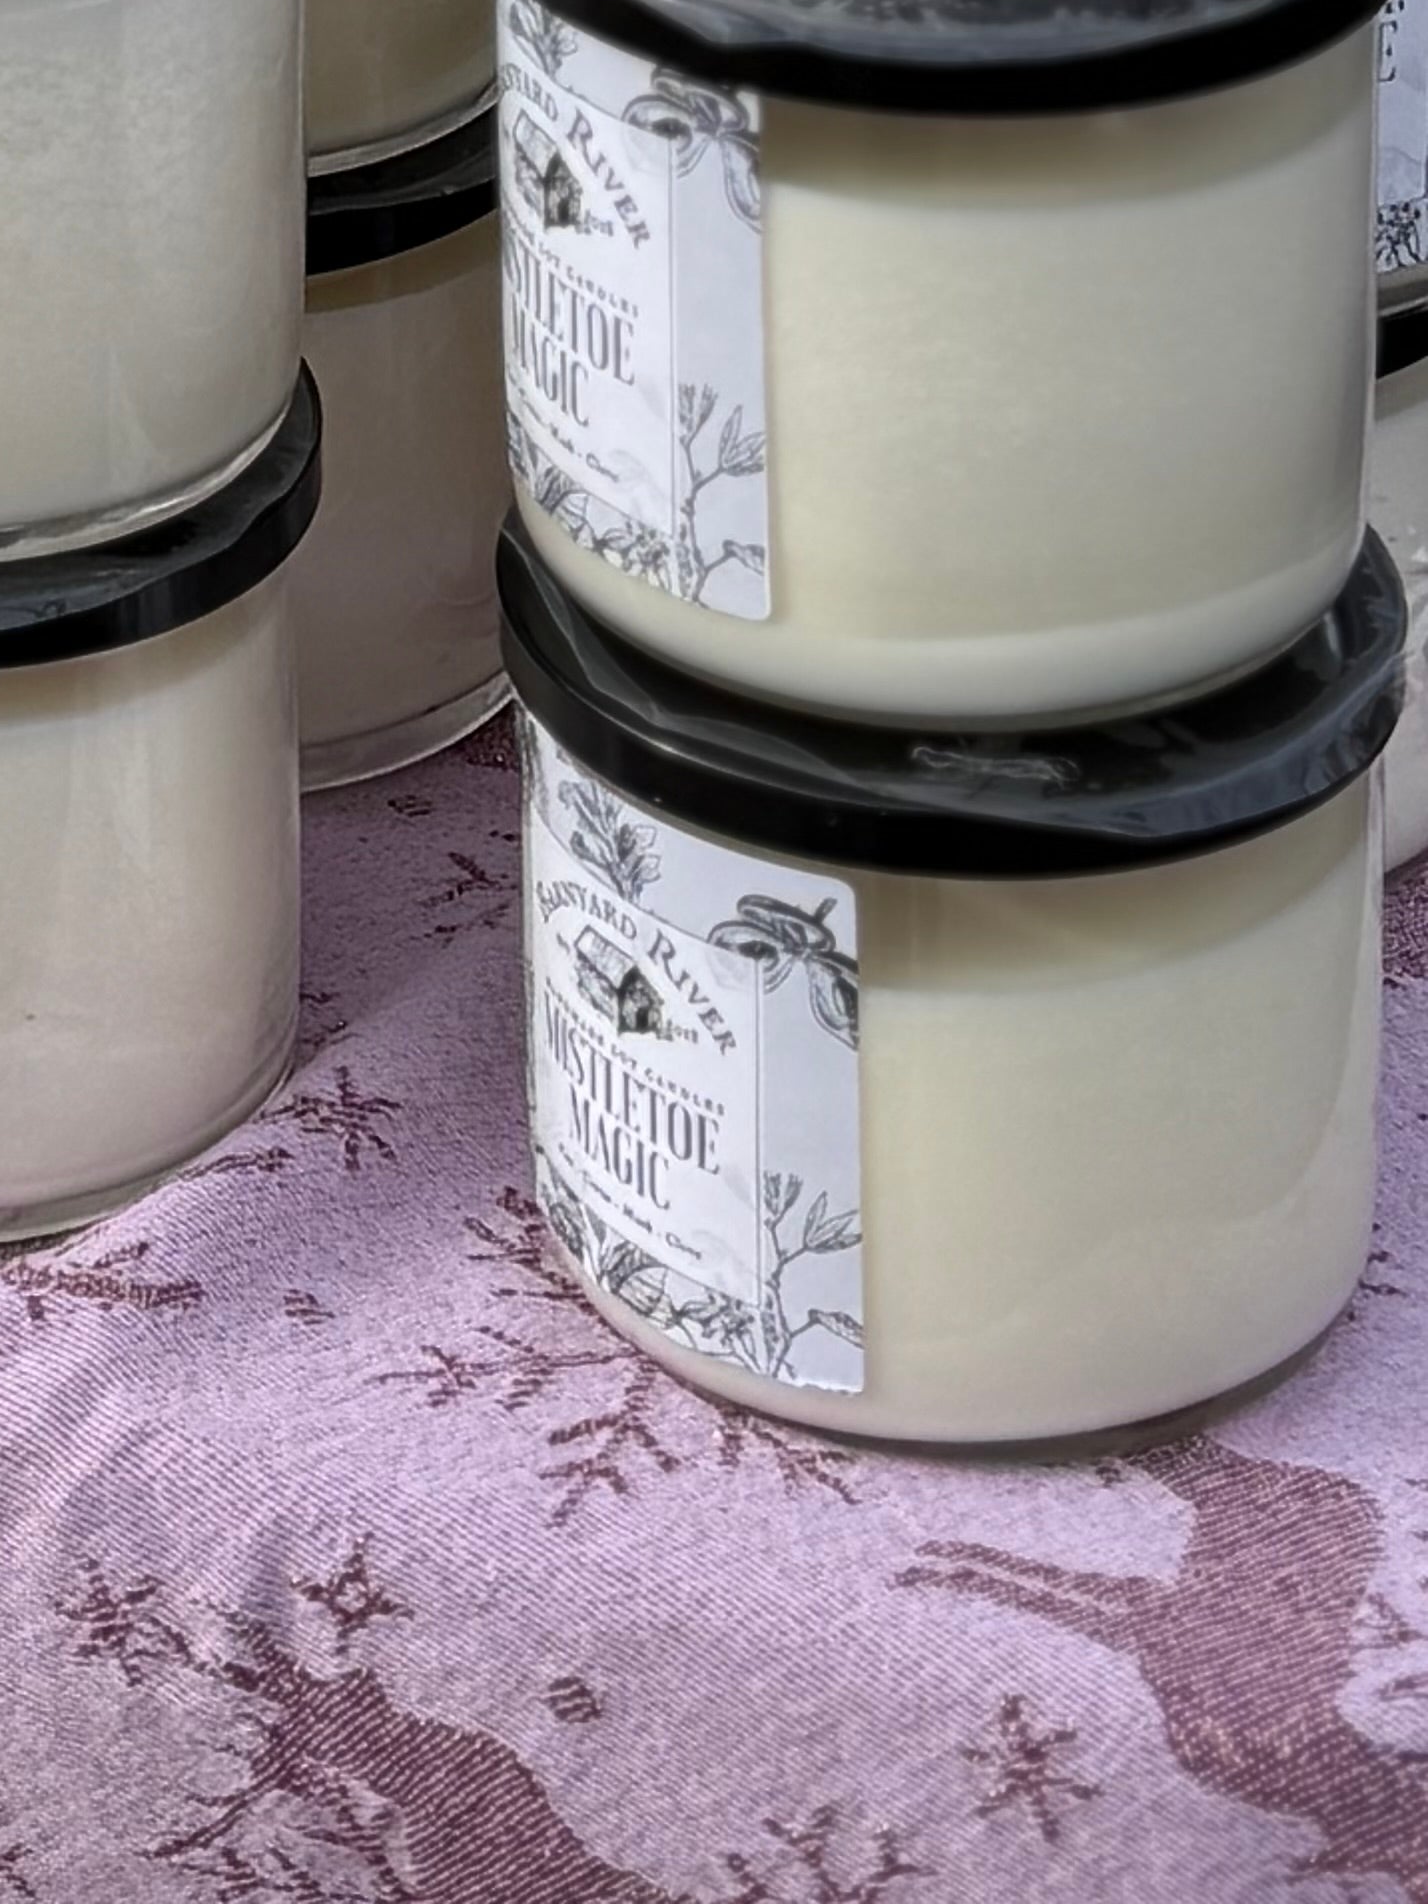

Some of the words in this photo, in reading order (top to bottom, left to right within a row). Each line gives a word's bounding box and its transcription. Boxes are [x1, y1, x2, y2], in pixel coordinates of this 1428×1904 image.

[567, 106, 650, 249] RIVER
[648, 928, 736, 1056] RIVER
[544, 992, 719, 1175] MISTLETOE
[570, 1082, 669, 1211] MAGIC
